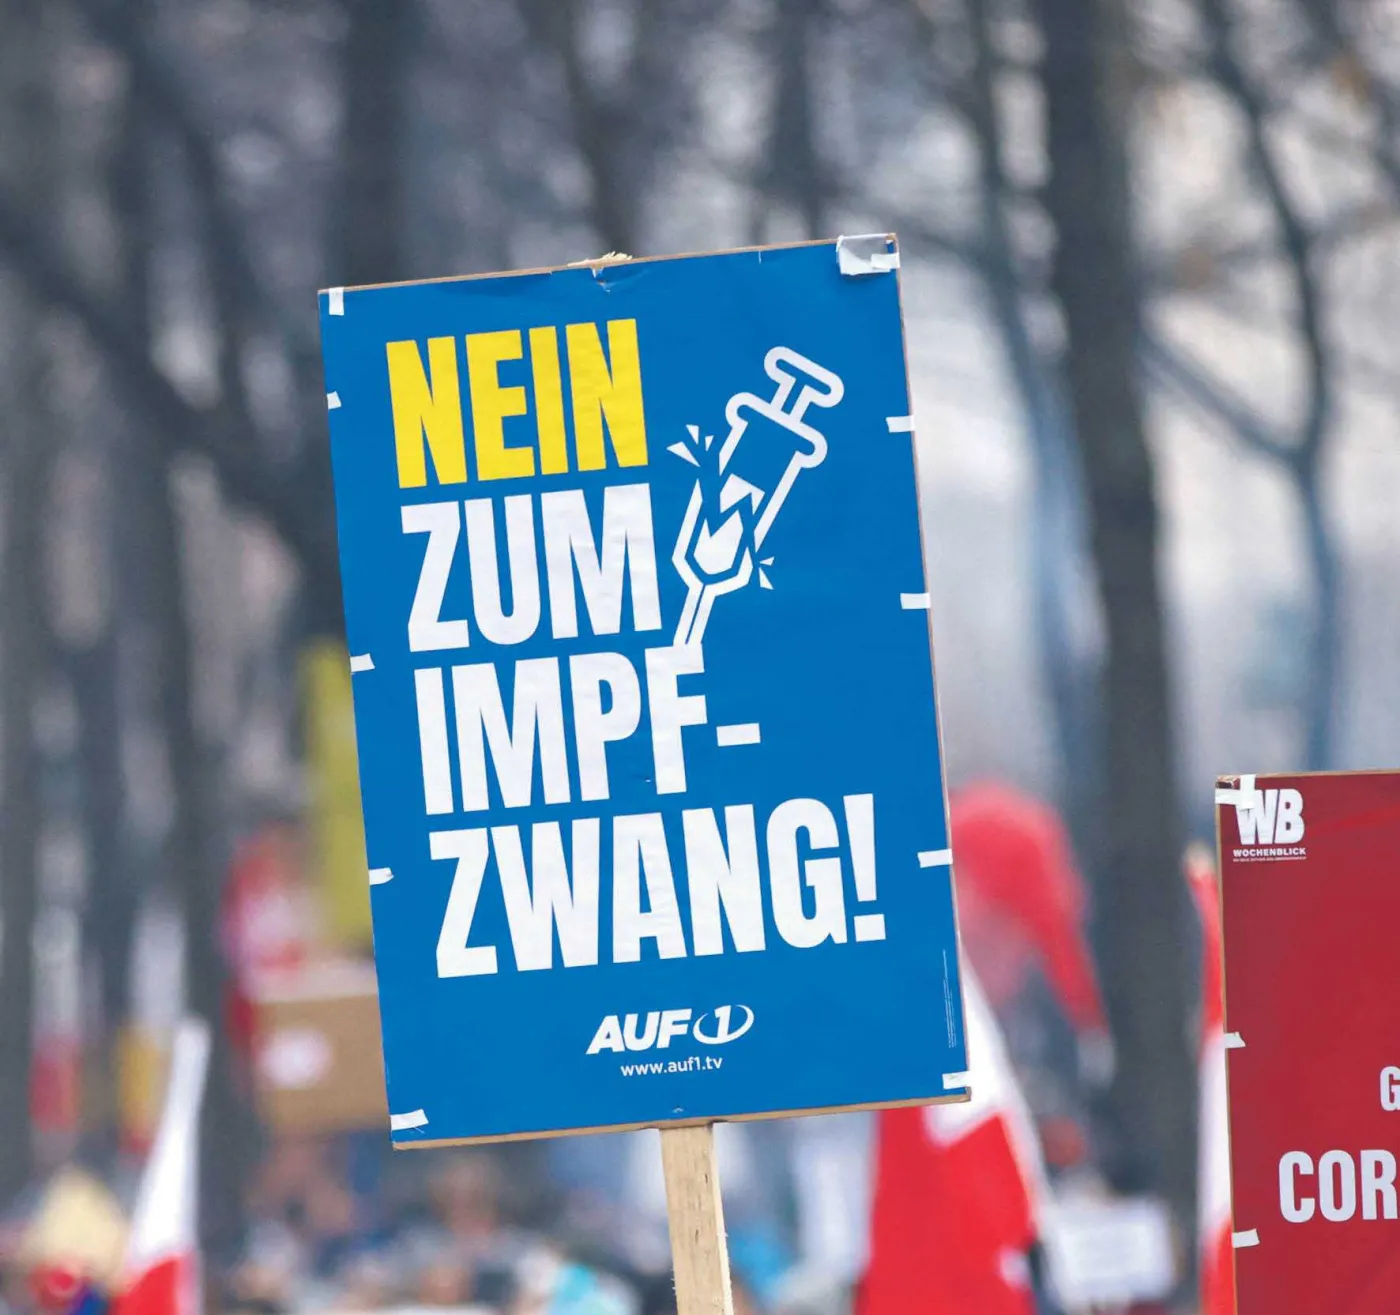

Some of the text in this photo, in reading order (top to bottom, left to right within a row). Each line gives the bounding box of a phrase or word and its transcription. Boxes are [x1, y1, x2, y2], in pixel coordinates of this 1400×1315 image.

[386, 318, 648, 489] NEIN
[400, 482, 662, 652] ZUM
[414, 642, 761, 815] IMPF-
[429, 793, 886, 978] ZWANG!
[1232, 847, 1307, 858] WOCHENBLICK
[1233, 788, 1305, 846] WB
[620, 1056, 723, 1077] www.auf1.tv
